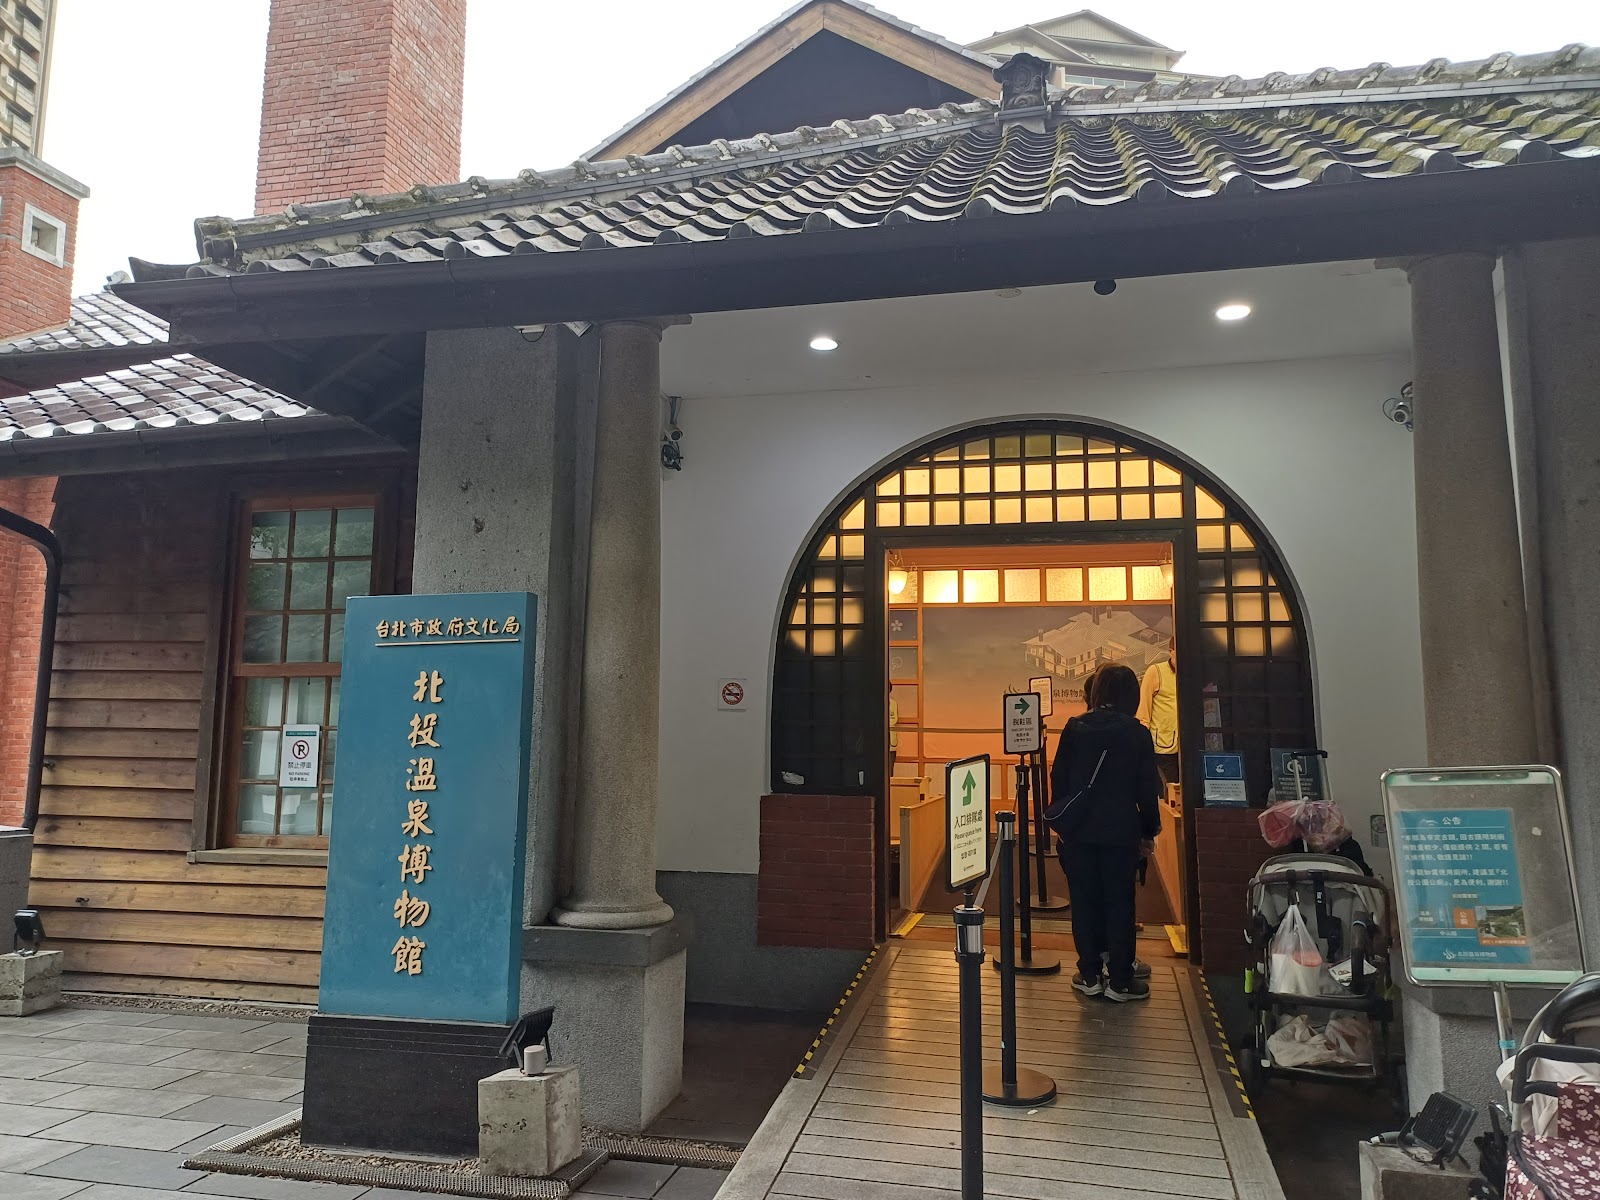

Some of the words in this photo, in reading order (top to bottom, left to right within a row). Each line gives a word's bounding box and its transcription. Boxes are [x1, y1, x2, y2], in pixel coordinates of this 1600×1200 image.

[375, 615, 521, 639] 台北市政府文化局
[390, 669, 444, 977] 北投溫泉博物館
[954, 809, 983, 830] 入口排隊處
[1441, 816, 1462, 825] 公告
